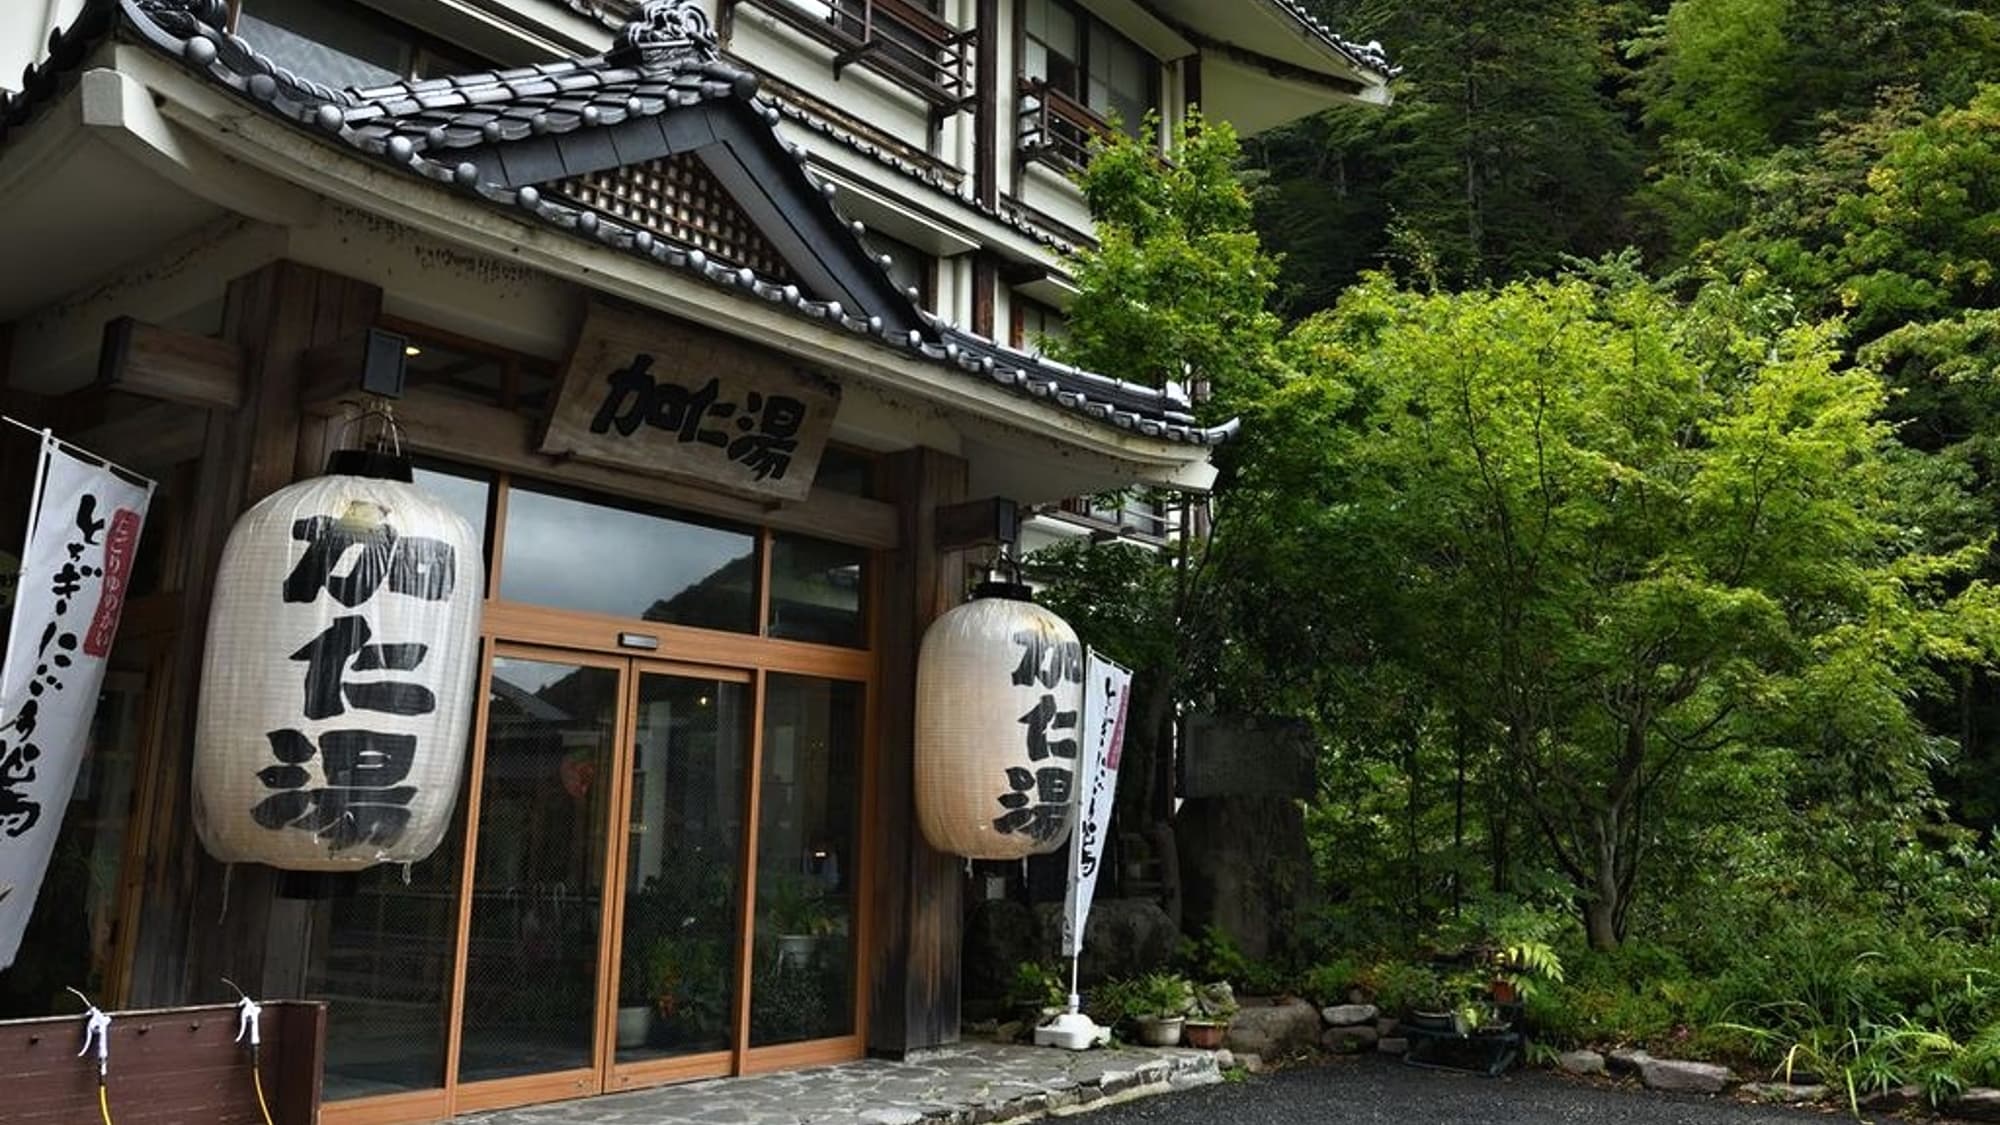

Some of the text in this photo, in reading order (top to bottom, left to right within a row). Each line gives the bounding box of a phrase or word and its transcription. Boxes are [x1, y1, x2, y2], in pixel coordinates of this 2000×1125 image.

[589, 353, 806, 482] 加仁湯
[249, 514, 457, 851] 加仁湯
[993, 630, 1083, 843] 加仁湯
